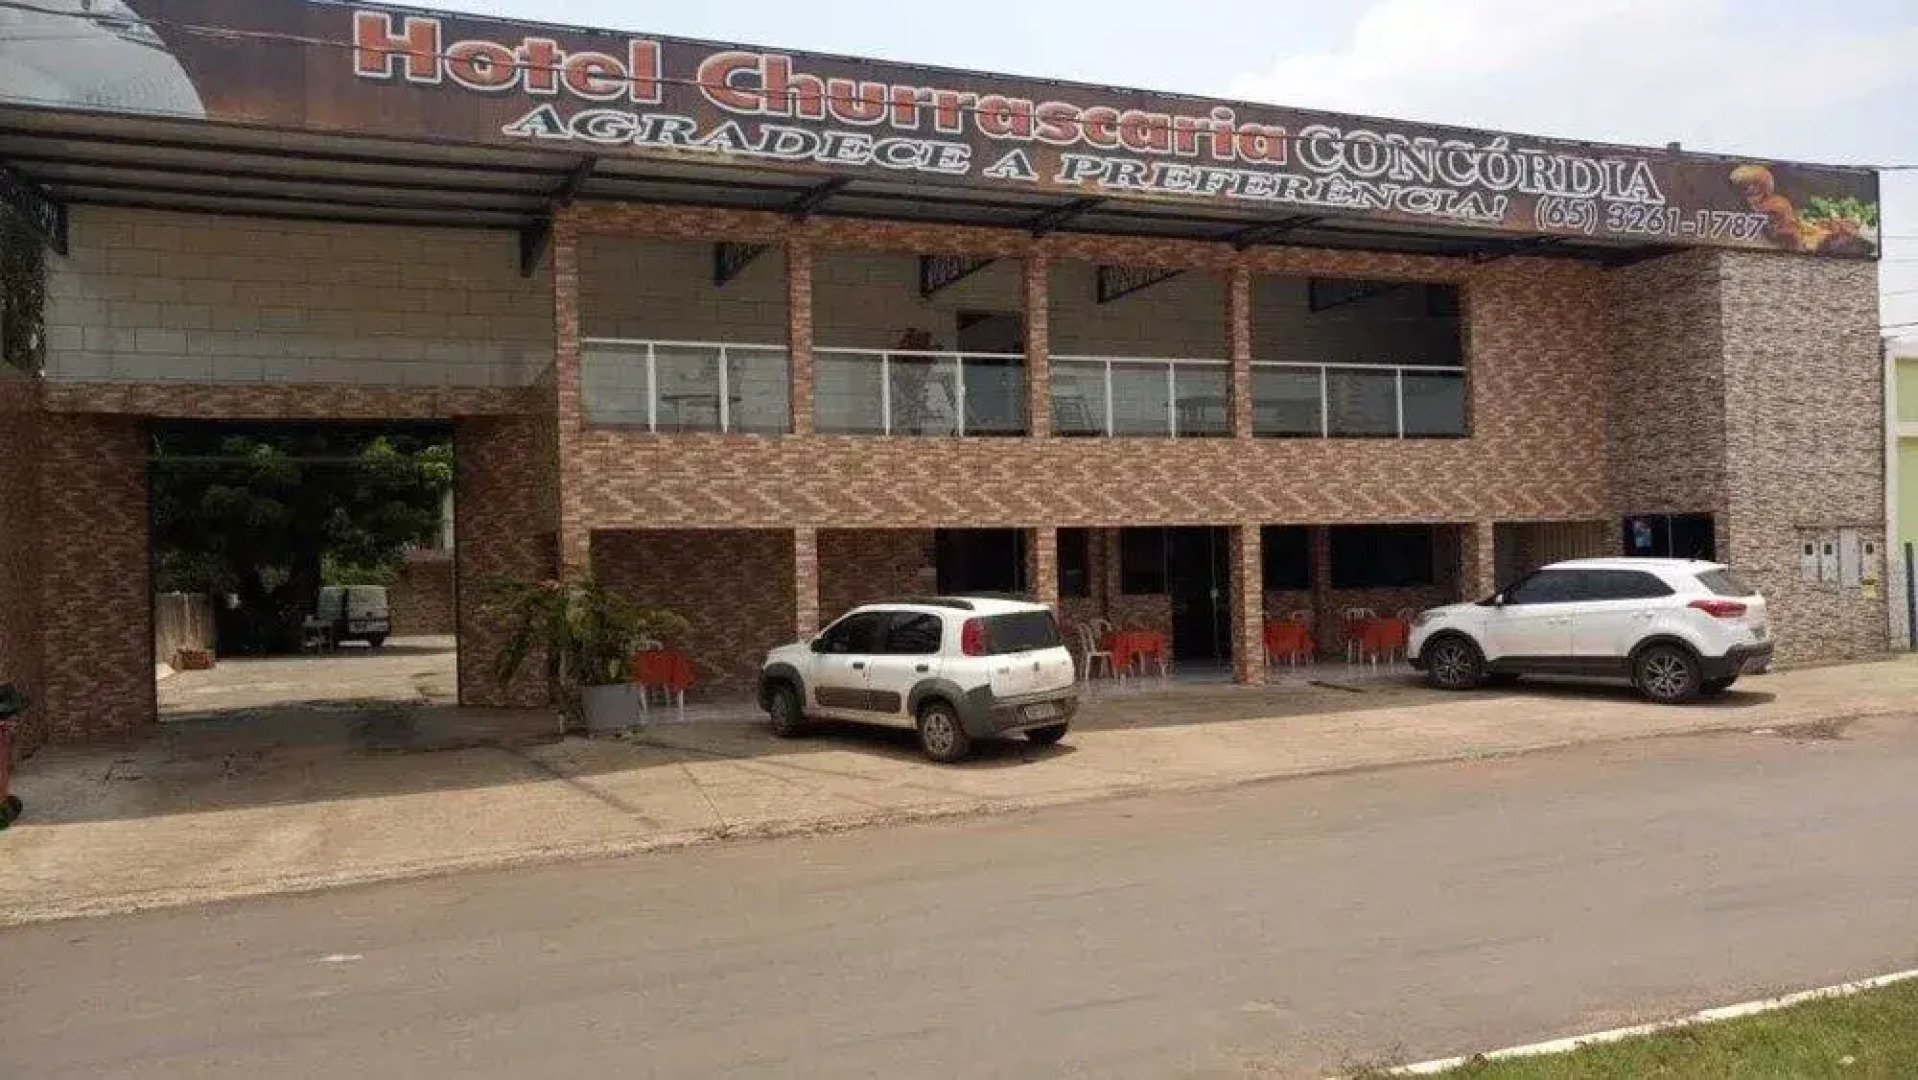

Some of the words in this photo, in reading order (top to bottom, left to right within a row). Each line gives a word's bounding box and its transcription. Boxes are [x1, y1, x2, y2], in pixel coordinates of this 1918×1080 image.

[353, 11, 662, 103] Hotel
[697, 50, 1288, 165] Churrascaria
[1296, 124, 1665, 204] CONCÓRDIA
[502, 103, 972, 175] AGRADECE
[983, 148, 1039, 181] A
[1055, 153, 1508, 222] PREFERÊNCIA!
[1534, 197, 1598, 234] (65)
[1605, 203, 1769, 240] 3261-1787
